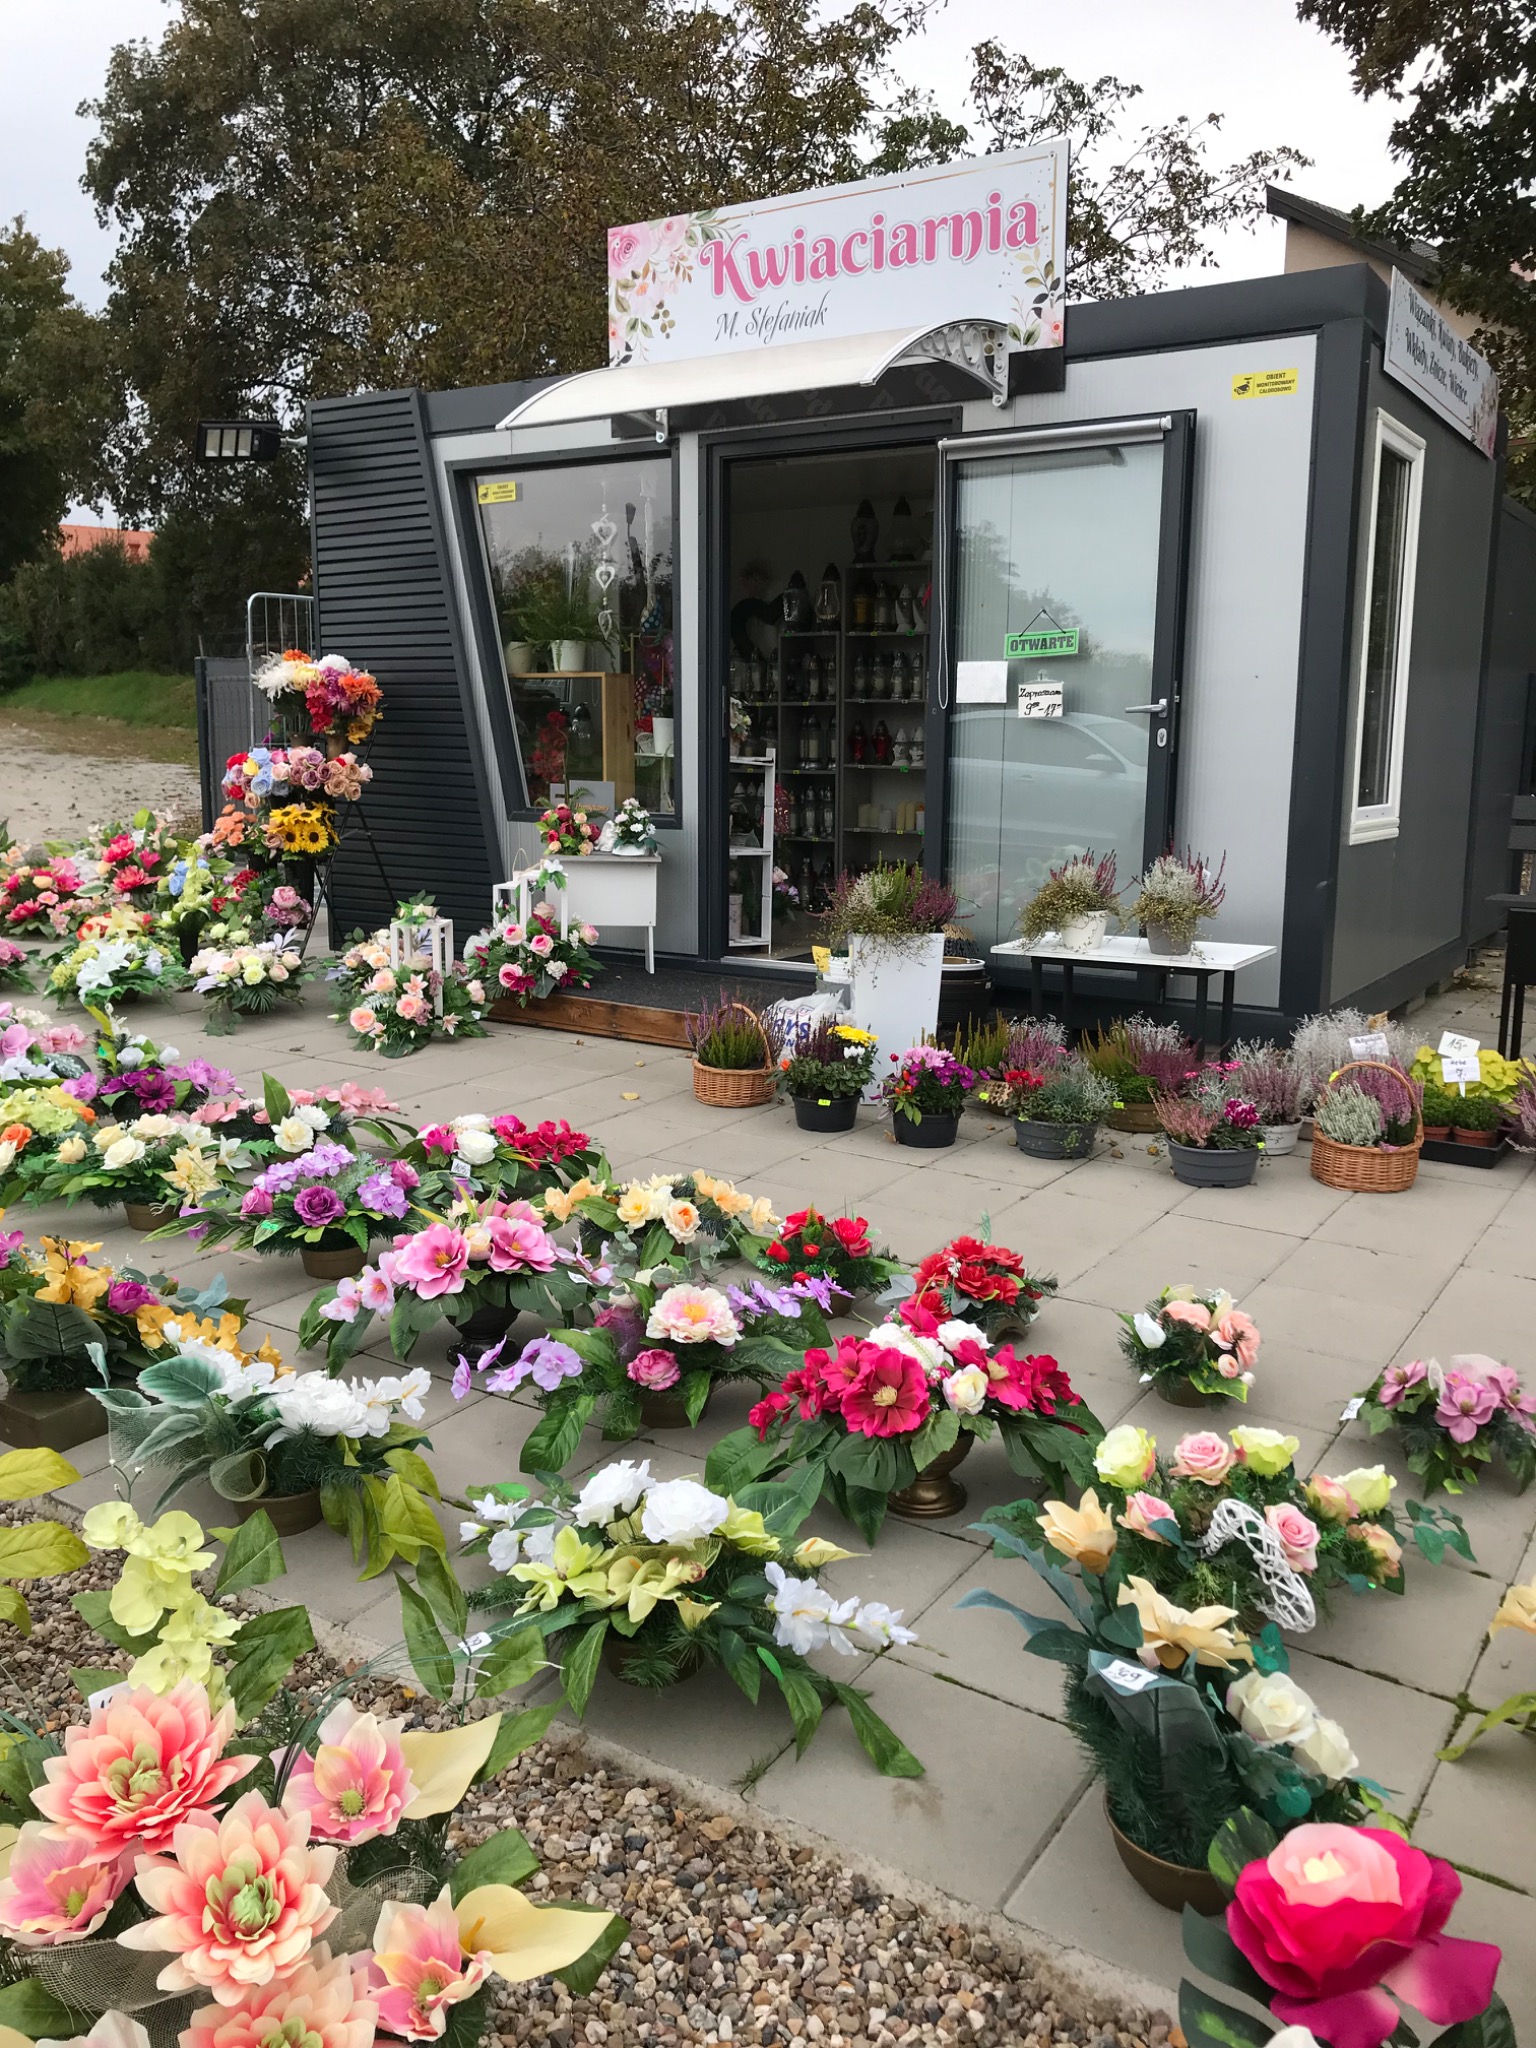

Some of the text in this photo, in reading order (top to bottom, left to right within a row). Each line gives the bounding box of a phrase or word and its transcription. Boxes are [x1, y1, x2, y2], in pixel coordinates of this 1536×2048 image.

[699, 191, 1039, 303] Kwiaciarnia
[715, 290, 829, 345] M. Stefaniak
[1010, 635, 1075, 652] OTWARTE
